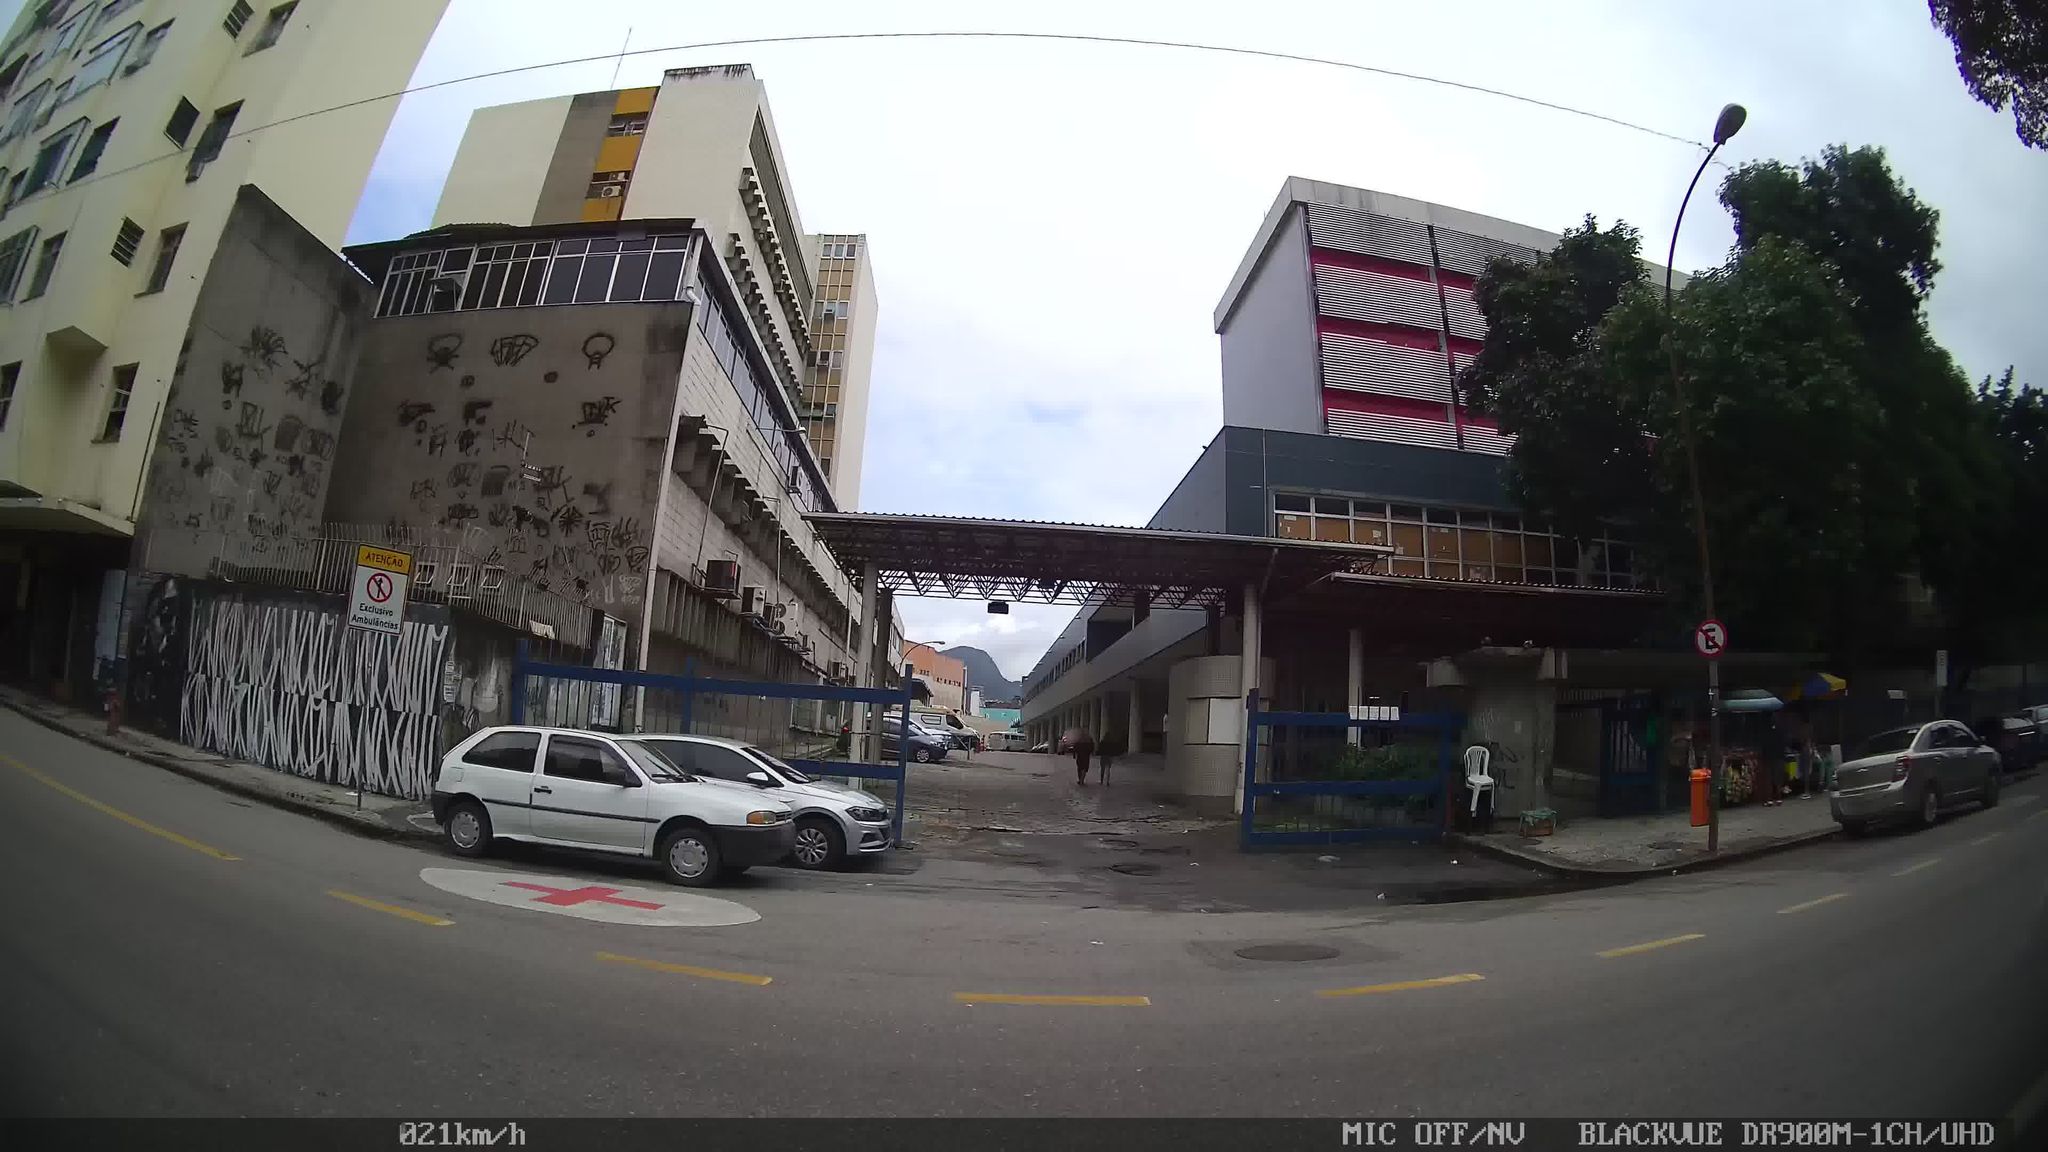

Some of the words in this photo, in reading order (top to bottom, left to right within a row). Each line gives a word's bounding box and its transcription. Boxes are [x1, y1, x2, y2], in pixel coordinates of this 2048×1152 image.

[366, 552, 404, 568] ATENÇÃO
[360, 603, 394, 616] Exclusivo
[351, 614, 399, 630] Ambulâncias
[1704, 628, 1718, 650] E
